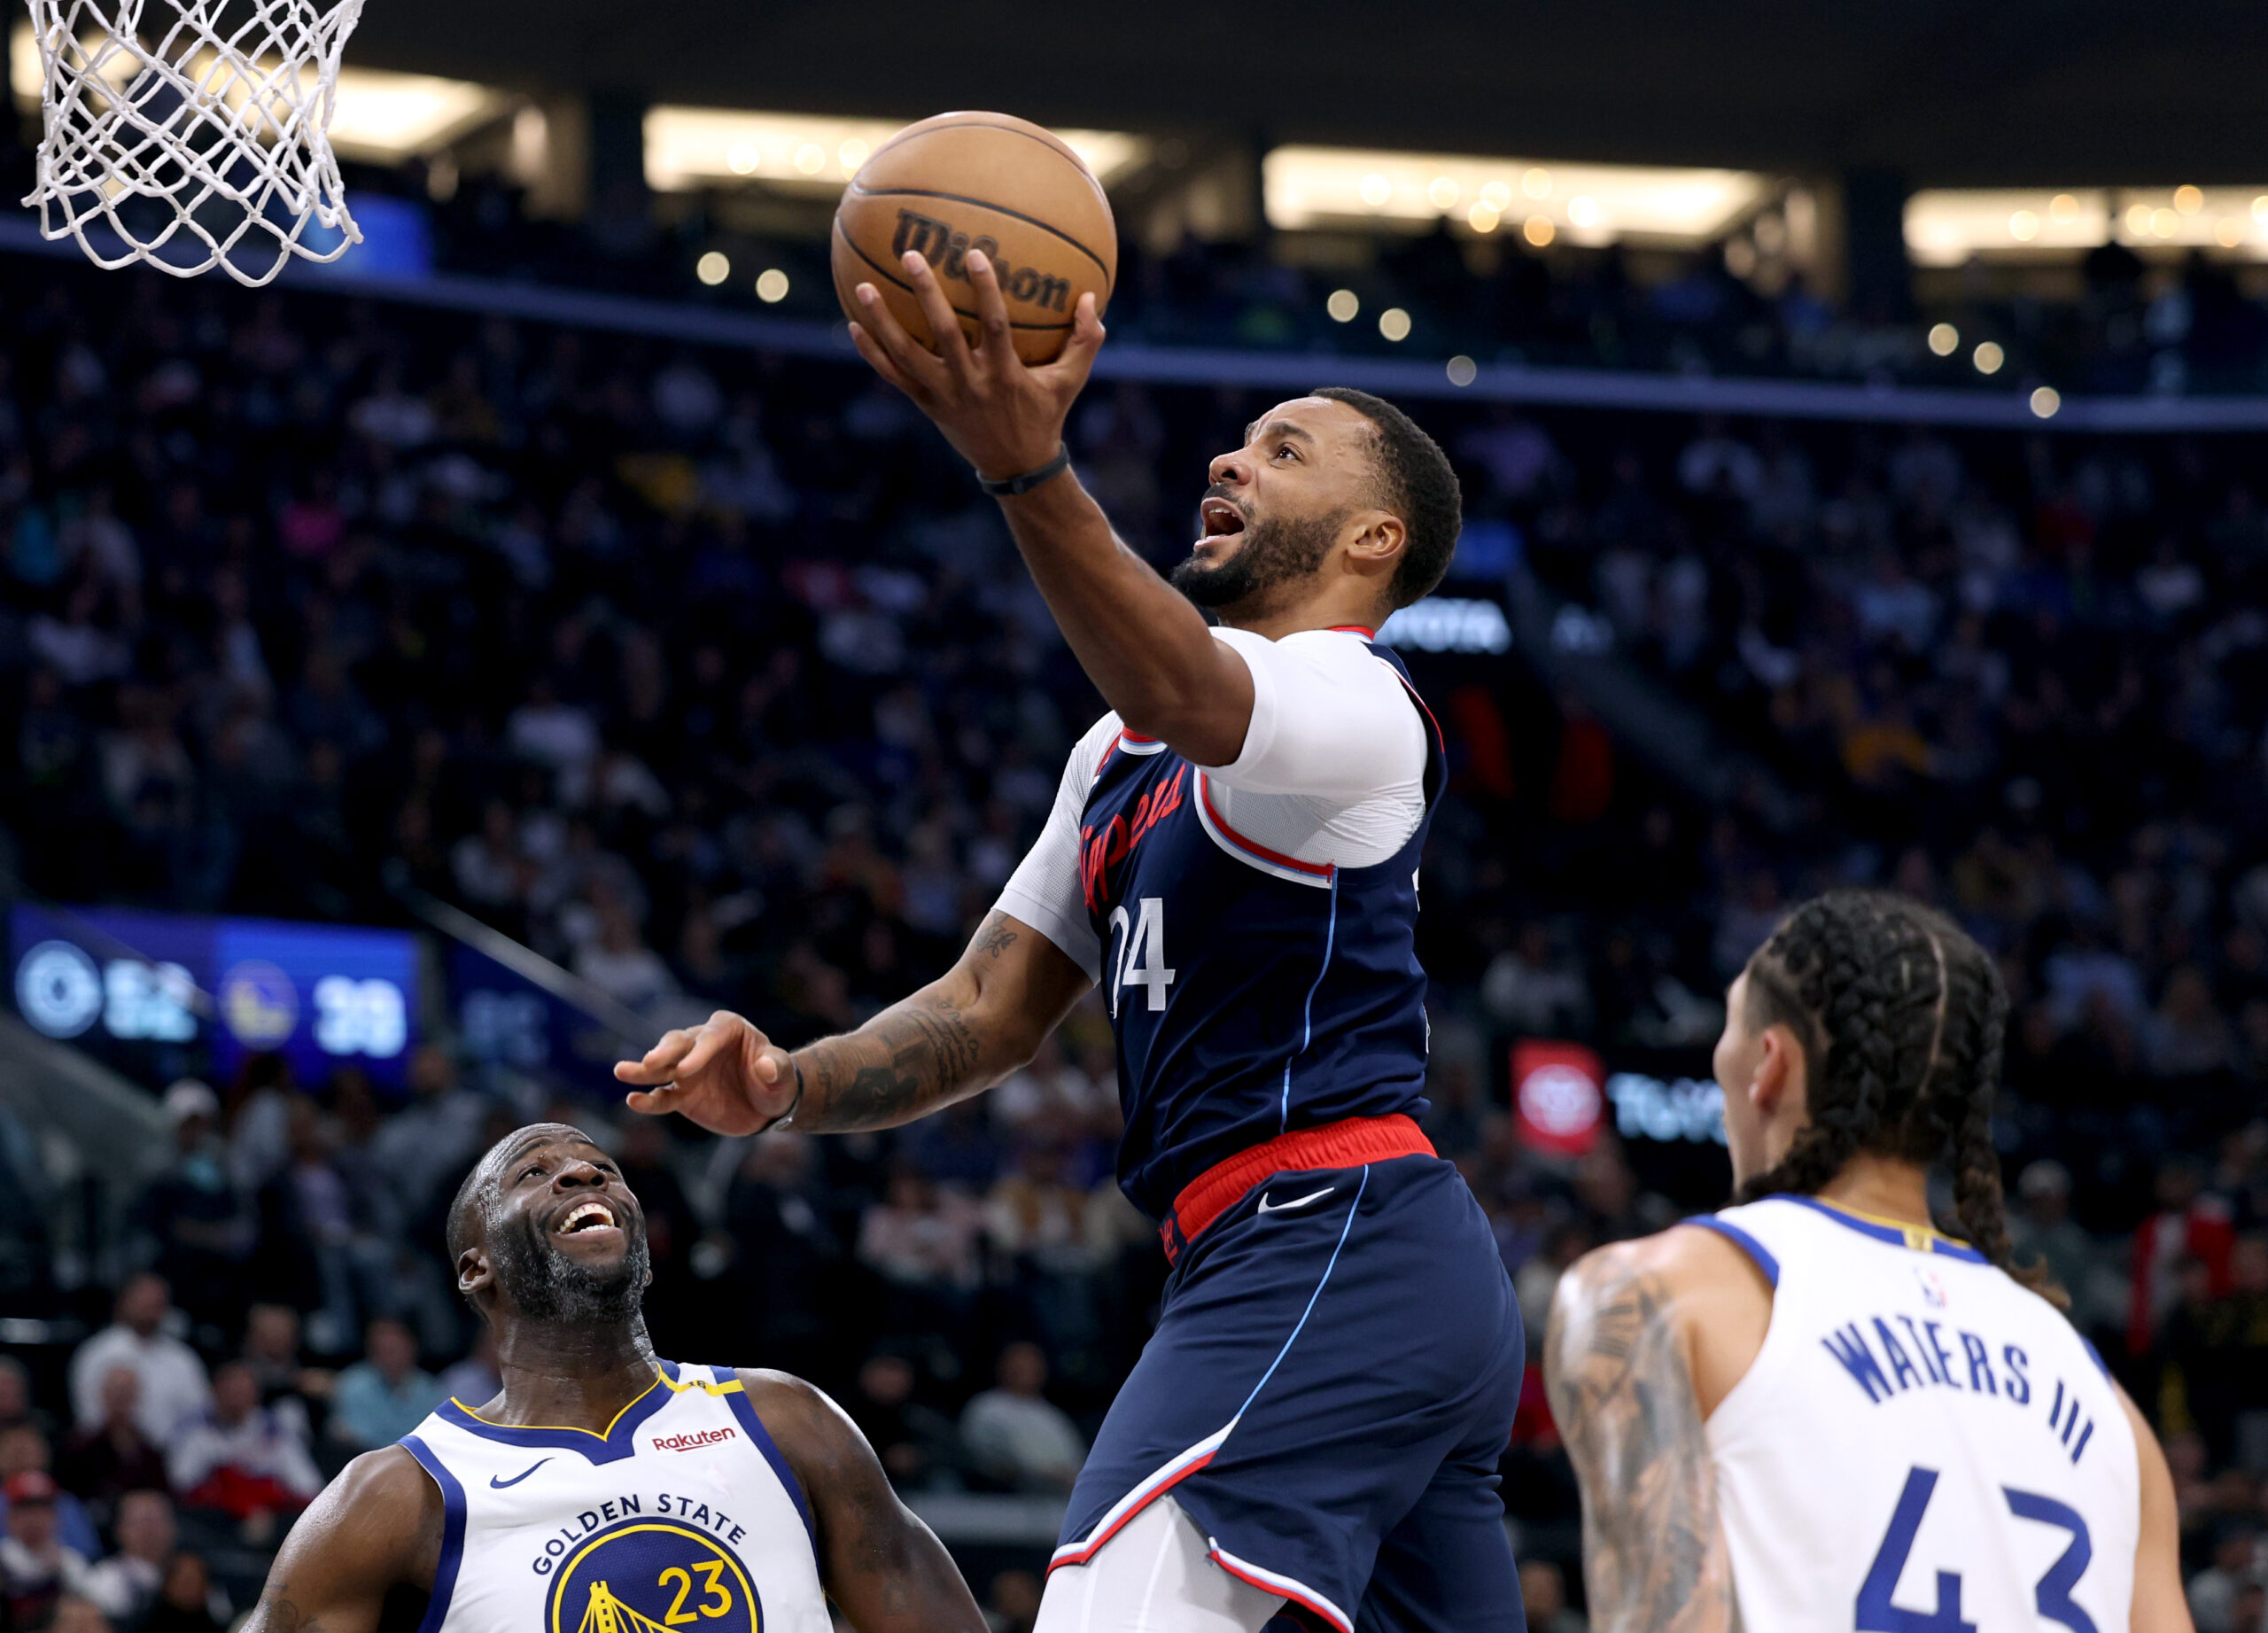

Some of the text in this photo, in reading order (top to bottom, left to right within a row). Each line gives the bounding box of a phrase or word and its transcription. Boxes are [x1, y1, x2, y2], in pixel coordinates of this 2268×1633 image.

[1821, 1315, 2094, 1466] WATERS III
[652, 1427, 736, 1451] Rakuten
[532, 1493, 747, 1575] GOLDEN STATE
[1853, 1464, 2101, 1633] 43
[658, 1559, 733, 1626] 23
